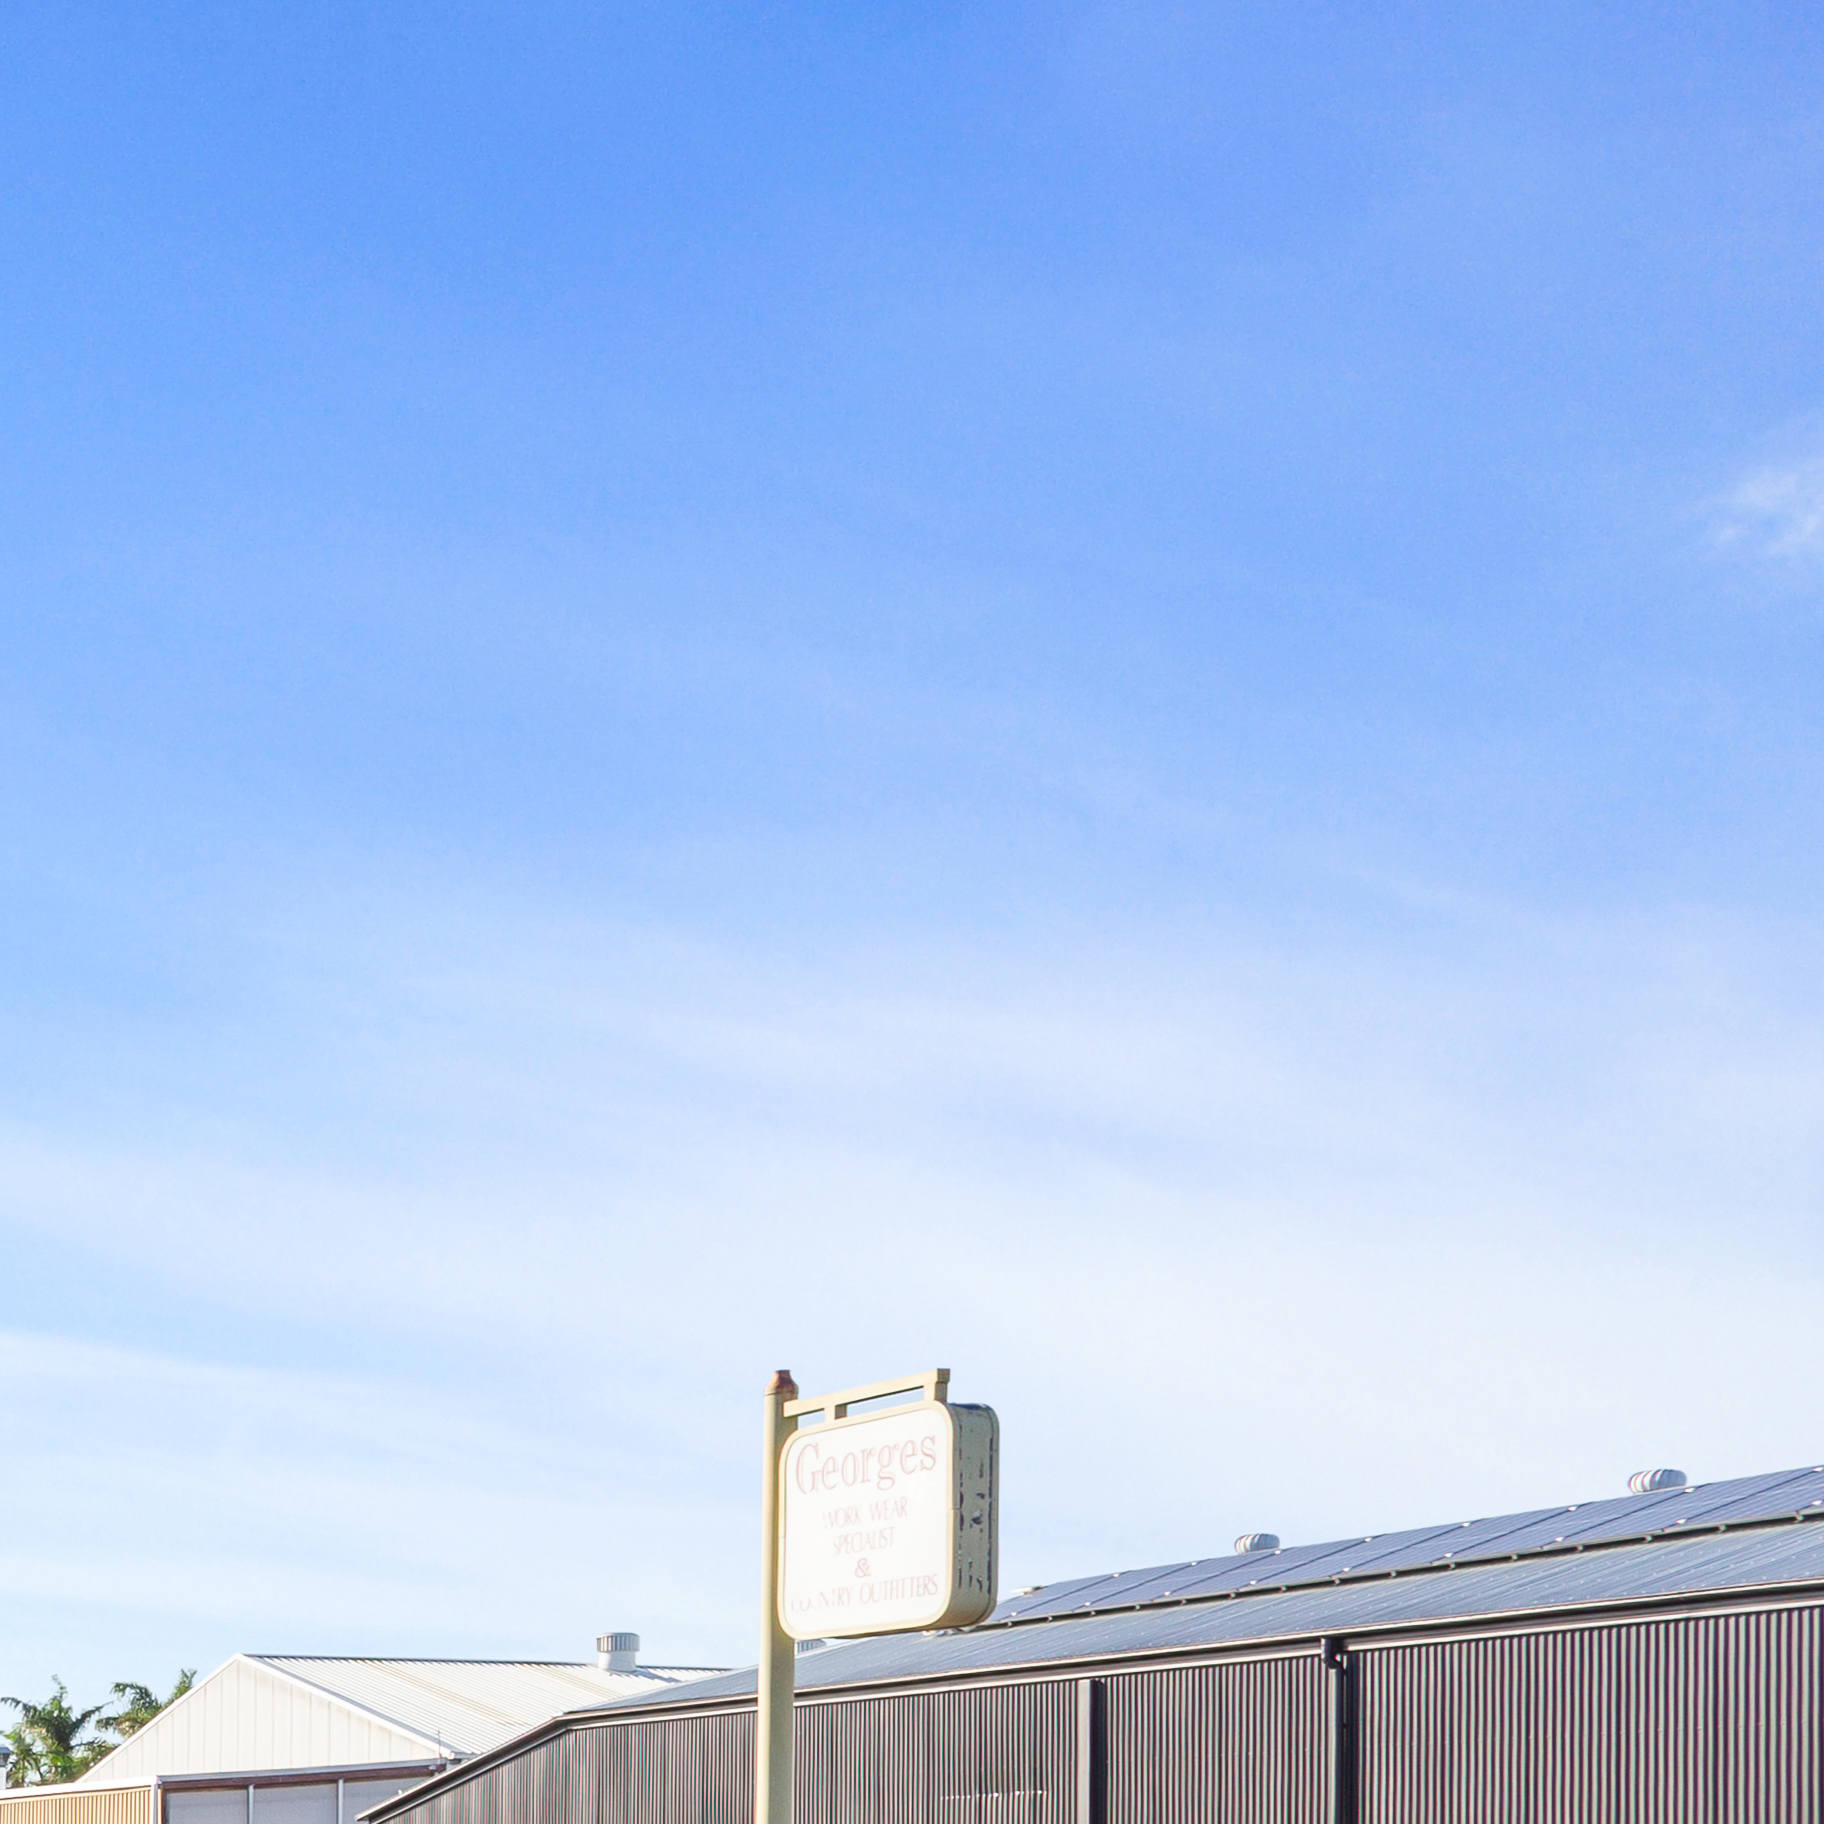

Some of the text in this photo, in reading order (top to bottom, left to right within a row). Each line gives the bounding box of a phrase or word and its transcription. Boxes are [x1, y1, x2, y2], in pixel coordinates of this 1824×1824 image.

[796, 1434, 938, 1494] Georges
[869, 1496, 909, 1522] WEAR
[854, 1557, 871, 1578] &
[859, 1573, 939, 1605] OUTFITTERS
